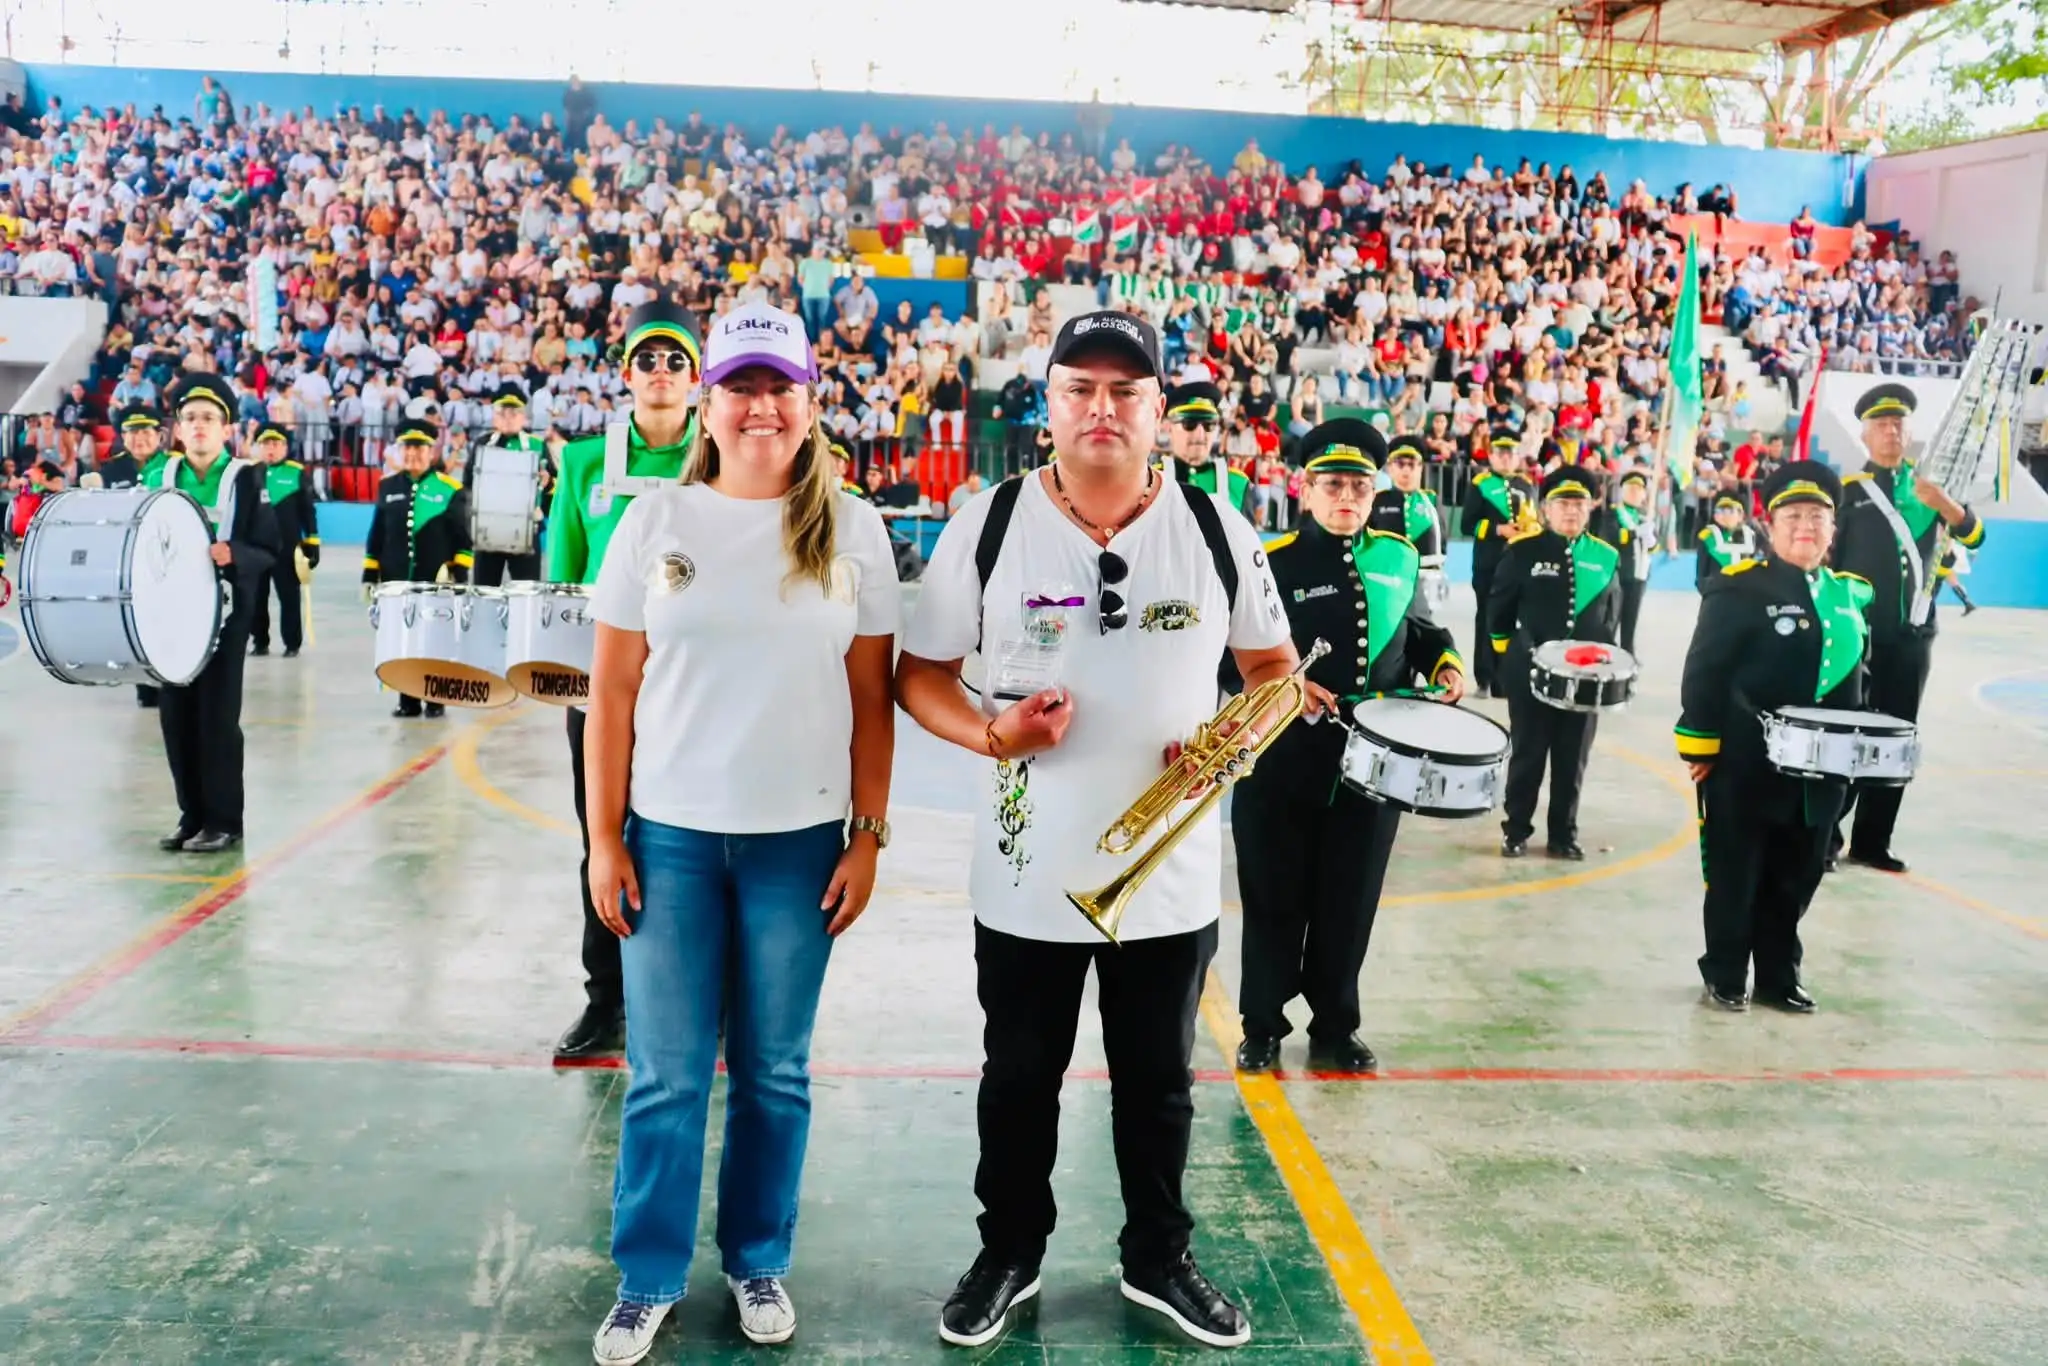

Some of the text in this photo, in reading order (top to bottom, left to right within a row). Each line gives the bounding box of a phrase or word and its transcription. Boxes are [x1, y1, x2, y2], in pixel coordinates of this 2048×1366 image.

[725, 318, 789, 336] Laura
[424, 674, 490, 703] TOMGRASSO
[530, 670, 590, 698] TOMGRASS
